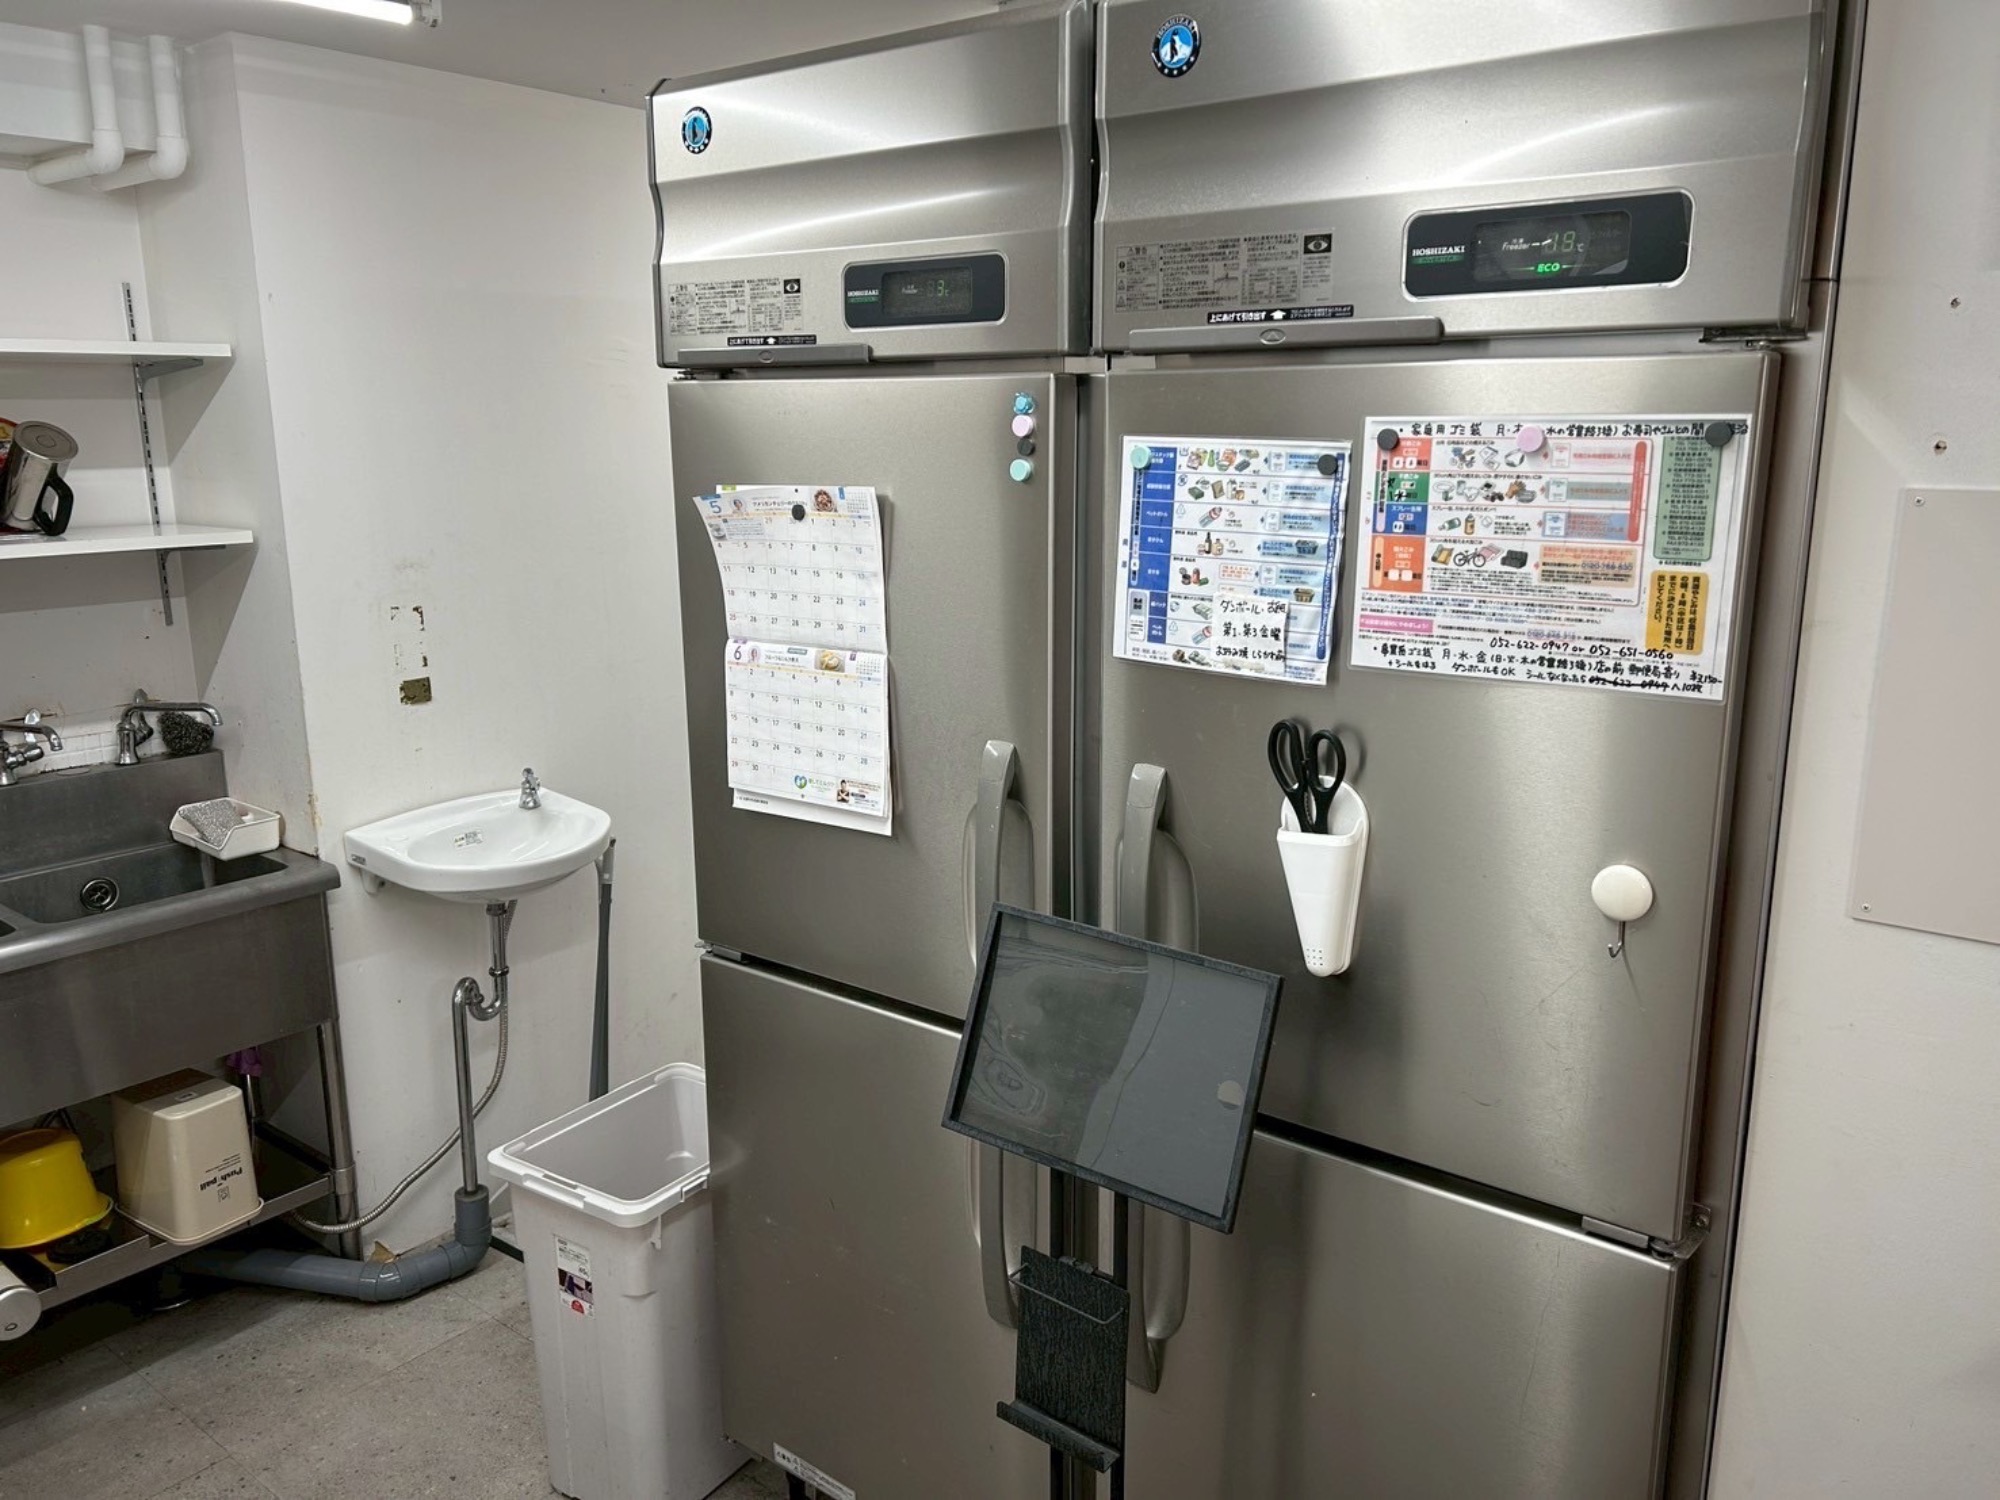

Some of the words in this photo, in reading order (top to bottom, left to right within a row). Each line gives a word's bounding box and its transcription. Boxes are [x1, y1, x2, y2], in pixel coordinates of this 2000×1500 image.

[1411, 244, 1465, 258] HOSHIZAKI
[1502, 241, 1530, 252] Freezer
[1537, 262, 1561, 273] ECO
[1209, 311, 1267, 323] 上にあげて引き出す
[709, 500, 722, 514] 5
[734, 645, 742, 660] 6
[1489, 636, 1569, 653] 052-622-0947
[1571, 644, 1585, 653] or
[1589, 644, 1675, 660] 052-651-0560
[221, 1166, 242, 1182] Push
